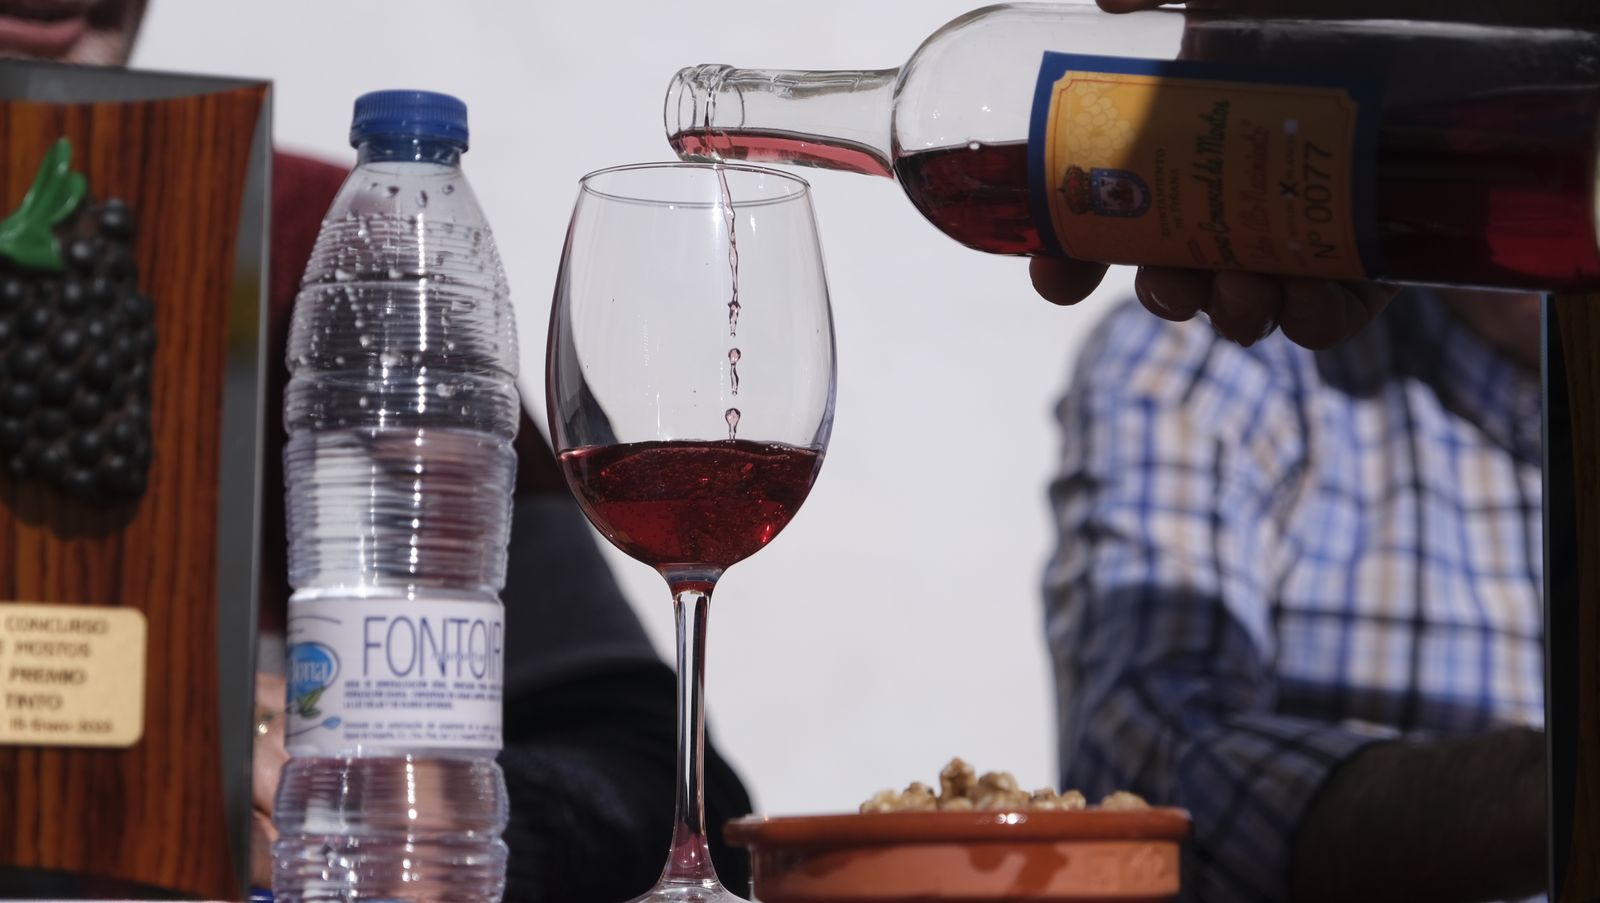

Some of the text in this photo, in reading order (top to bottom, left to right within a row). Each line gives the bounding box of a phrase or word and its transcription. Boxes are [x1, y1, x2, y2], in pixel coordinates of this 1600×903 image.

[1302, 141, 1333, 223] 0077
[4, 616, 109, 635] CONCURSO
[14, 639, 91, 658] MOSTOS
[8, 666, 87, 685] PREMIO
[5, 692, 63, 711] TINTO
